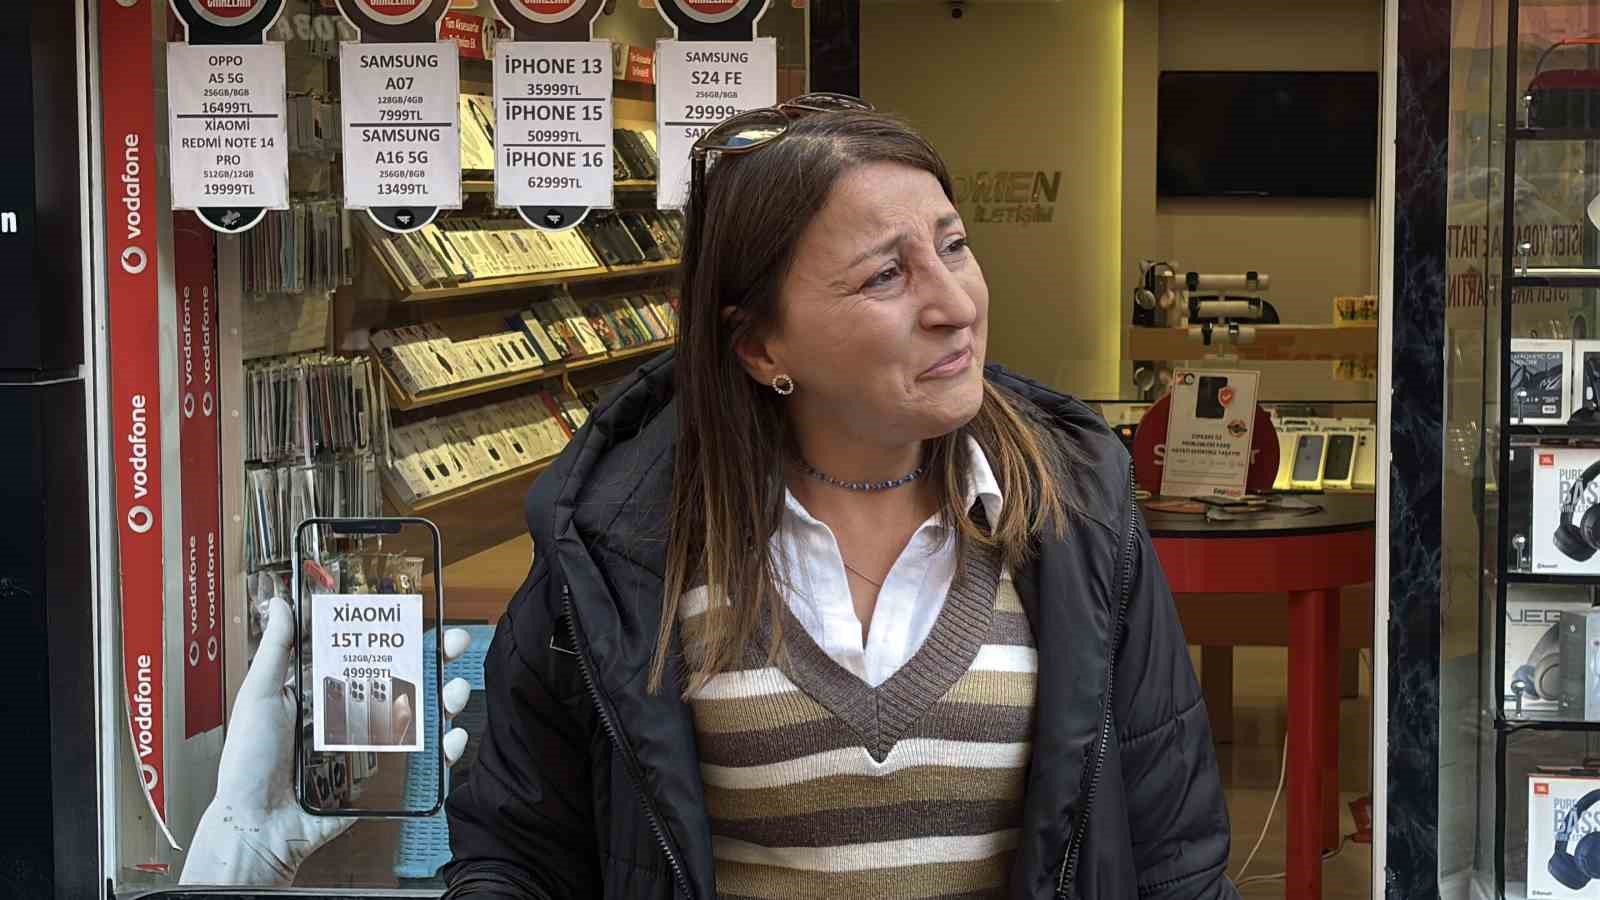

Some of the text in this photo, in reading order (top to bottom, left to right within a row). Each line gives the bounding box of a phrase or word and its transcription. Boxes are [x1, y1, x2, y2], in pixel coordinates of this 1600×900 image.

[208, 56, 243, 67] OPPO
[360, 55, 439, 69] SAMSUNG
[505, 55, 603, 74] İPHONE 13
[686, 52, 749, 64] SAMSUNG
[208, 73, 244, 84] A5 5G
[385, 77, 414, 90] A07
[691, 71, 743, 85] S24 FE
[203, 88, 250, 97] 256GB/8GB
[527, 84, 582, 96] 35999TL
[695, 91, 738, 99] 256GB/8GB
[377, 96, 424, 104] 128GB/4GB
[202, 102, 254, 113] 16499TL
[505, 101, 603, 121] İPHONE 15
[685, 105, 745, 119] 29999
[379, 110, 423, 121] 7999TL
[205, 118, 250, 131] XİAOMİ
[182, 135, 275, 148] REDMİ NOTE 14
[362, 129, 440, 142] SAMSUNG
[527, 130, 582, 142] 50999TL
[216, 155, 241, 166] PRO
[375, 151, 428, 164] A16 5G
[506, 148, 604, 168] İPHONE 16
[203, 170, 254, 179] 512GB/12GB
[379, 170, 425, 178] 256GB/8GB
[122, 133, 140, 239] vodafone
[204, 184, 256, 195] 19999TL
[377, 184, 429, 195] 13499TL
[527, 177, 582, 189] 62999TL
[183, 286, 192, 384] vodafone
[202, 286, 210, 384] vodafone
[129, 394, 148, 498] vodafone
[188, 535, 198, 634] vodafone
[206, 532, 216, 629] vodafone
[333, 603, 401, 622] XİAOMİ
[331, 633, 405, 648] 15T PRO
[343, 655, 393, 663] 512GB/12GB
[343, 668, 392, 680] 49999TL
[134, 654, 151, 756] vodafone
